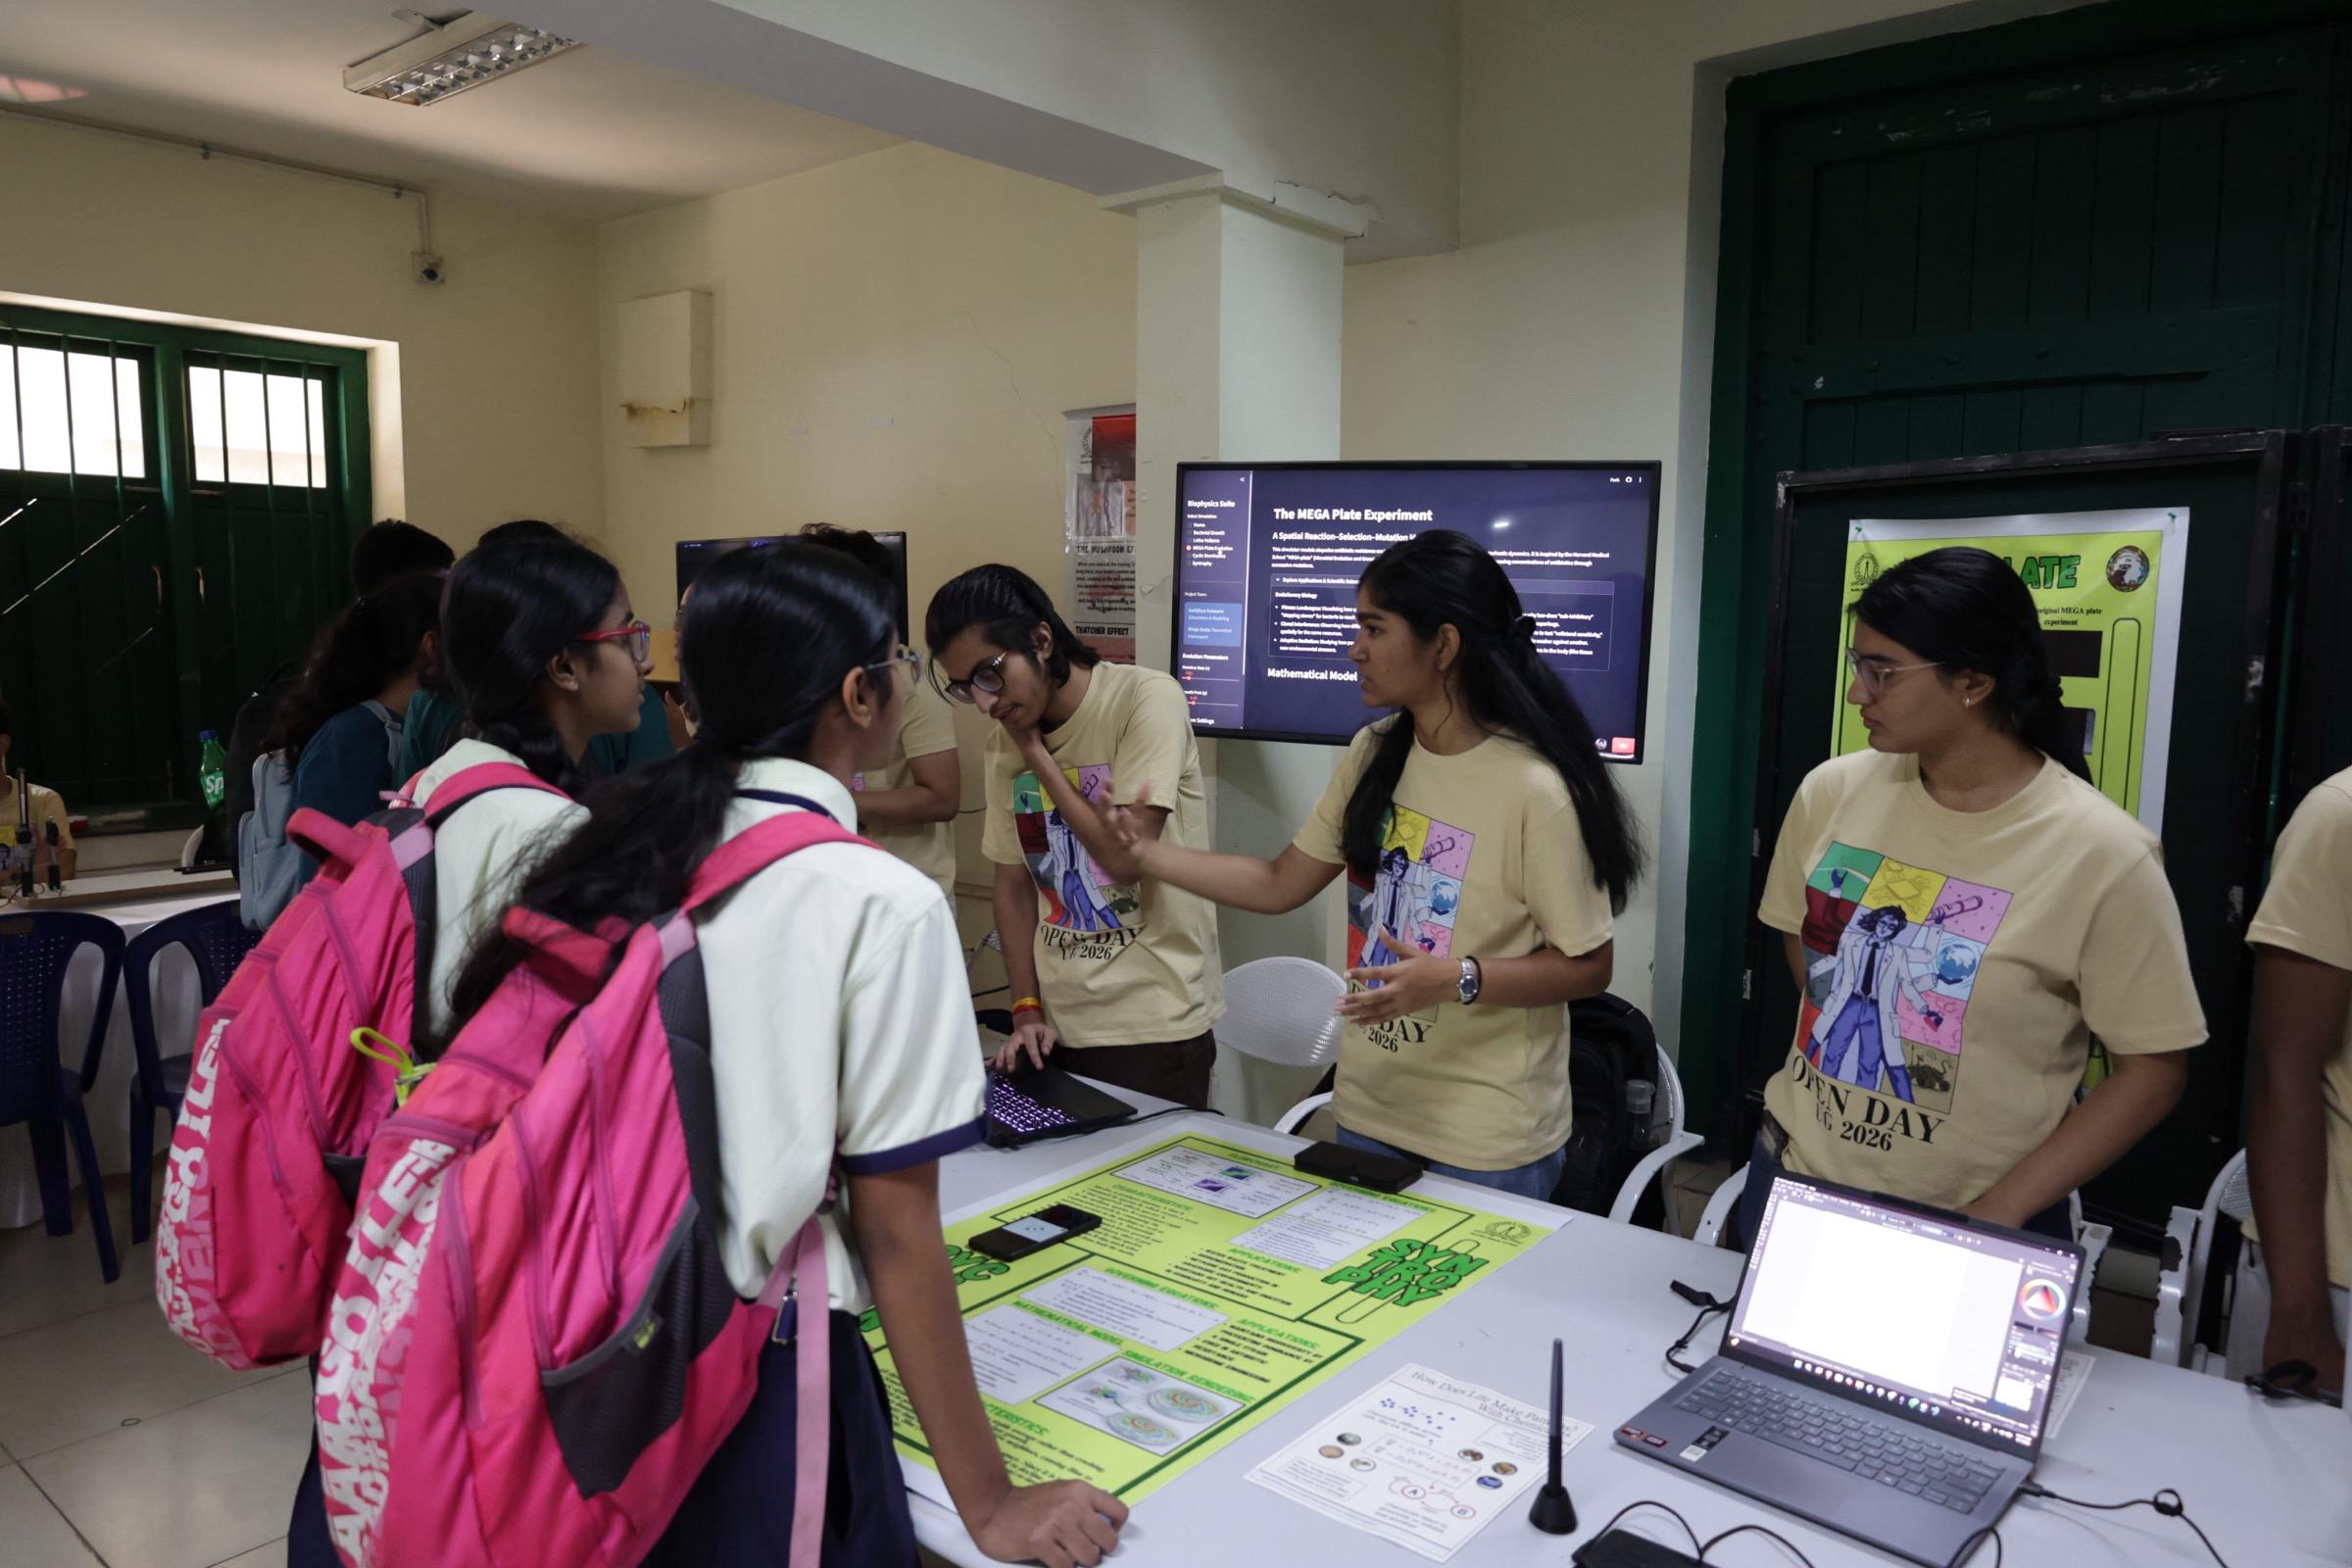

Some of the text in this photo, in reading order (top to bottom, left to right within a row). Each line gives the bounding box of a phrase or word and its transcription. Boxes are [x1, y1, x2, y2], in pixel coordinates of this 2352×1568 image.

[1274, 508, 1433, 522] The MEGA Plate Experiment
[1279, 532, 1303, 541] Spatial
[1075, 626, 1129, 636] THATCHER EFFECT
[1267, 667, 1357, 681] Mathematical Model
[1080, 945, 1112, 960] 2026
[1368, 1026, 1398, 1053] 2026
[1379, 1018, 1434, 1043] DAY
[1862, 1095, 1945, 1145] DAY
[1839, 1120, 1892, 1152] 2026
[1379, 1239, 1490, 1278] SYN
[1321, 1265, 1443, 1307] PHY
[1120, 1348, 1189, 1377] SIMULATION
[1407, 1371, 1528, 1416] How Does Life Make
[1471, 1402, 1507, 1418] With
